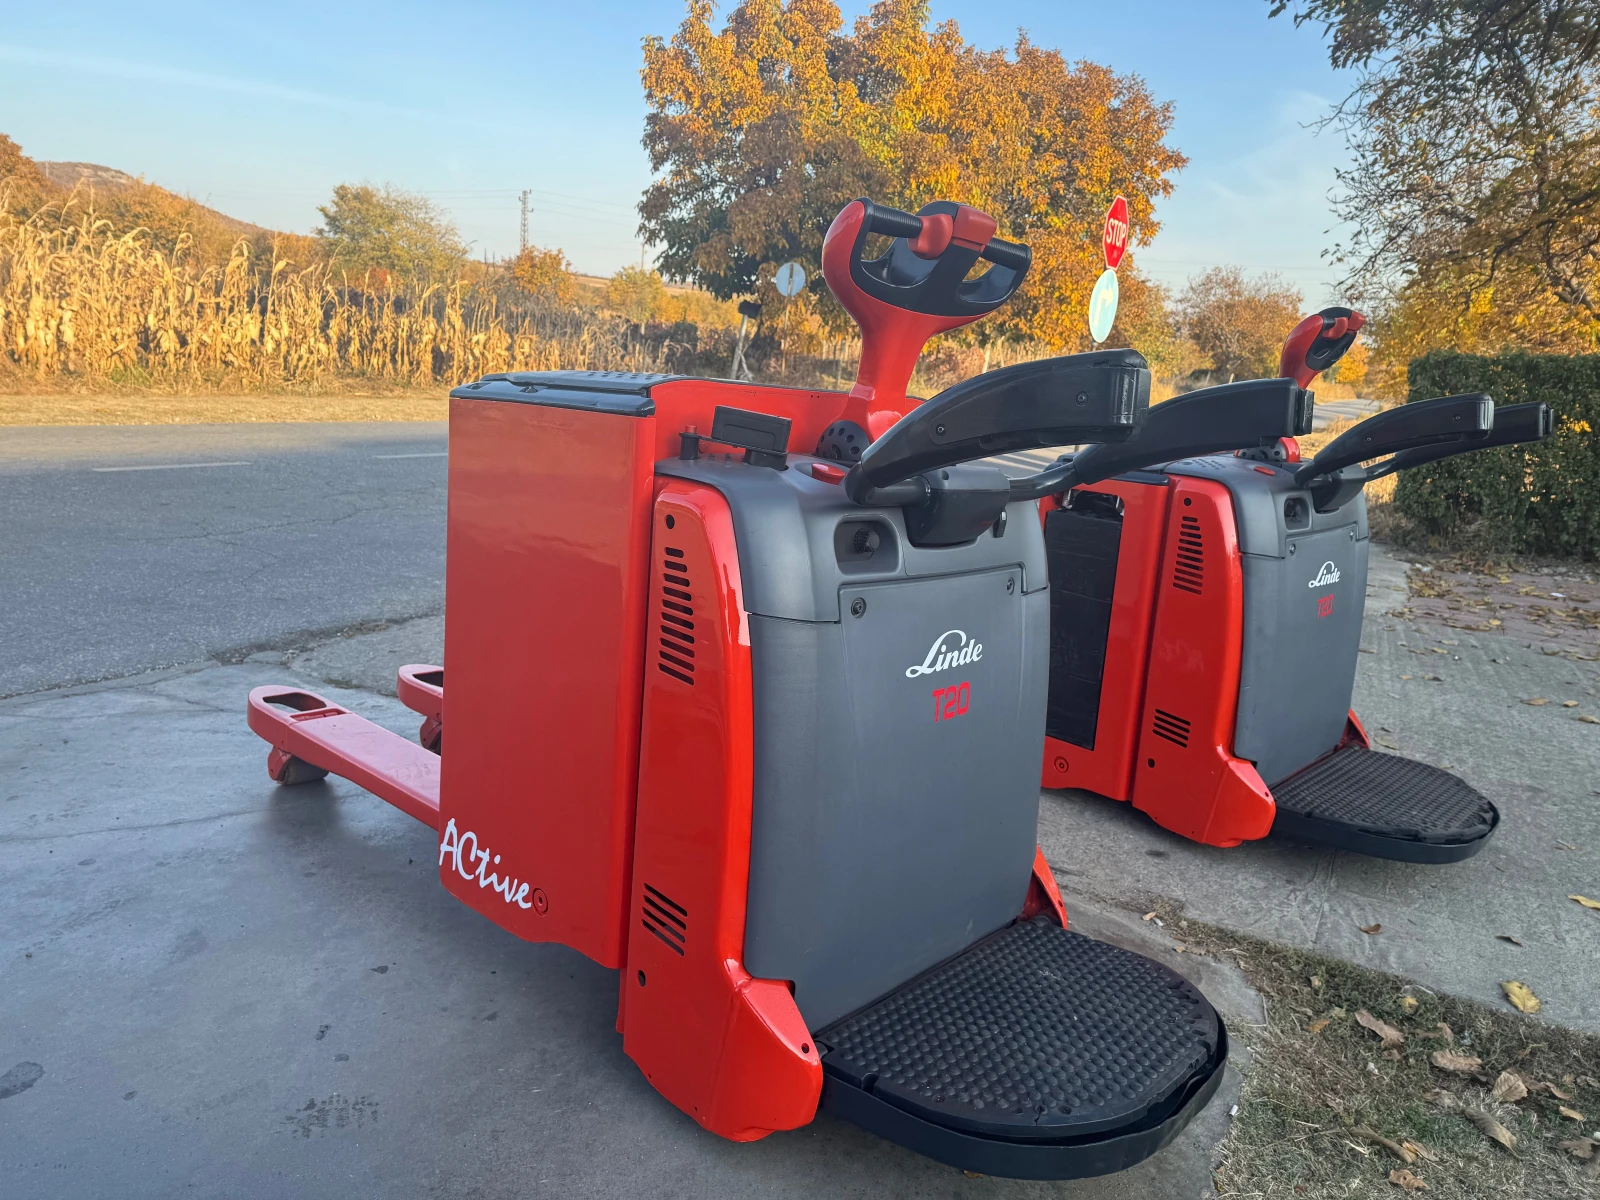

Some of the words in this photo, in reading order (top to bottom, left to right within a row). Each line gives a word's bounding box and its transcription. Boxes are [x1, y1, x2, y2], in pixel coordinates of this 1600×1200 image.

[1106, 218, 1126, 247] STOP
[1308, 561, 1340, 588] Linde
[905, 629, 983, 678] Linde
[932, 681, 971, 722] T20
